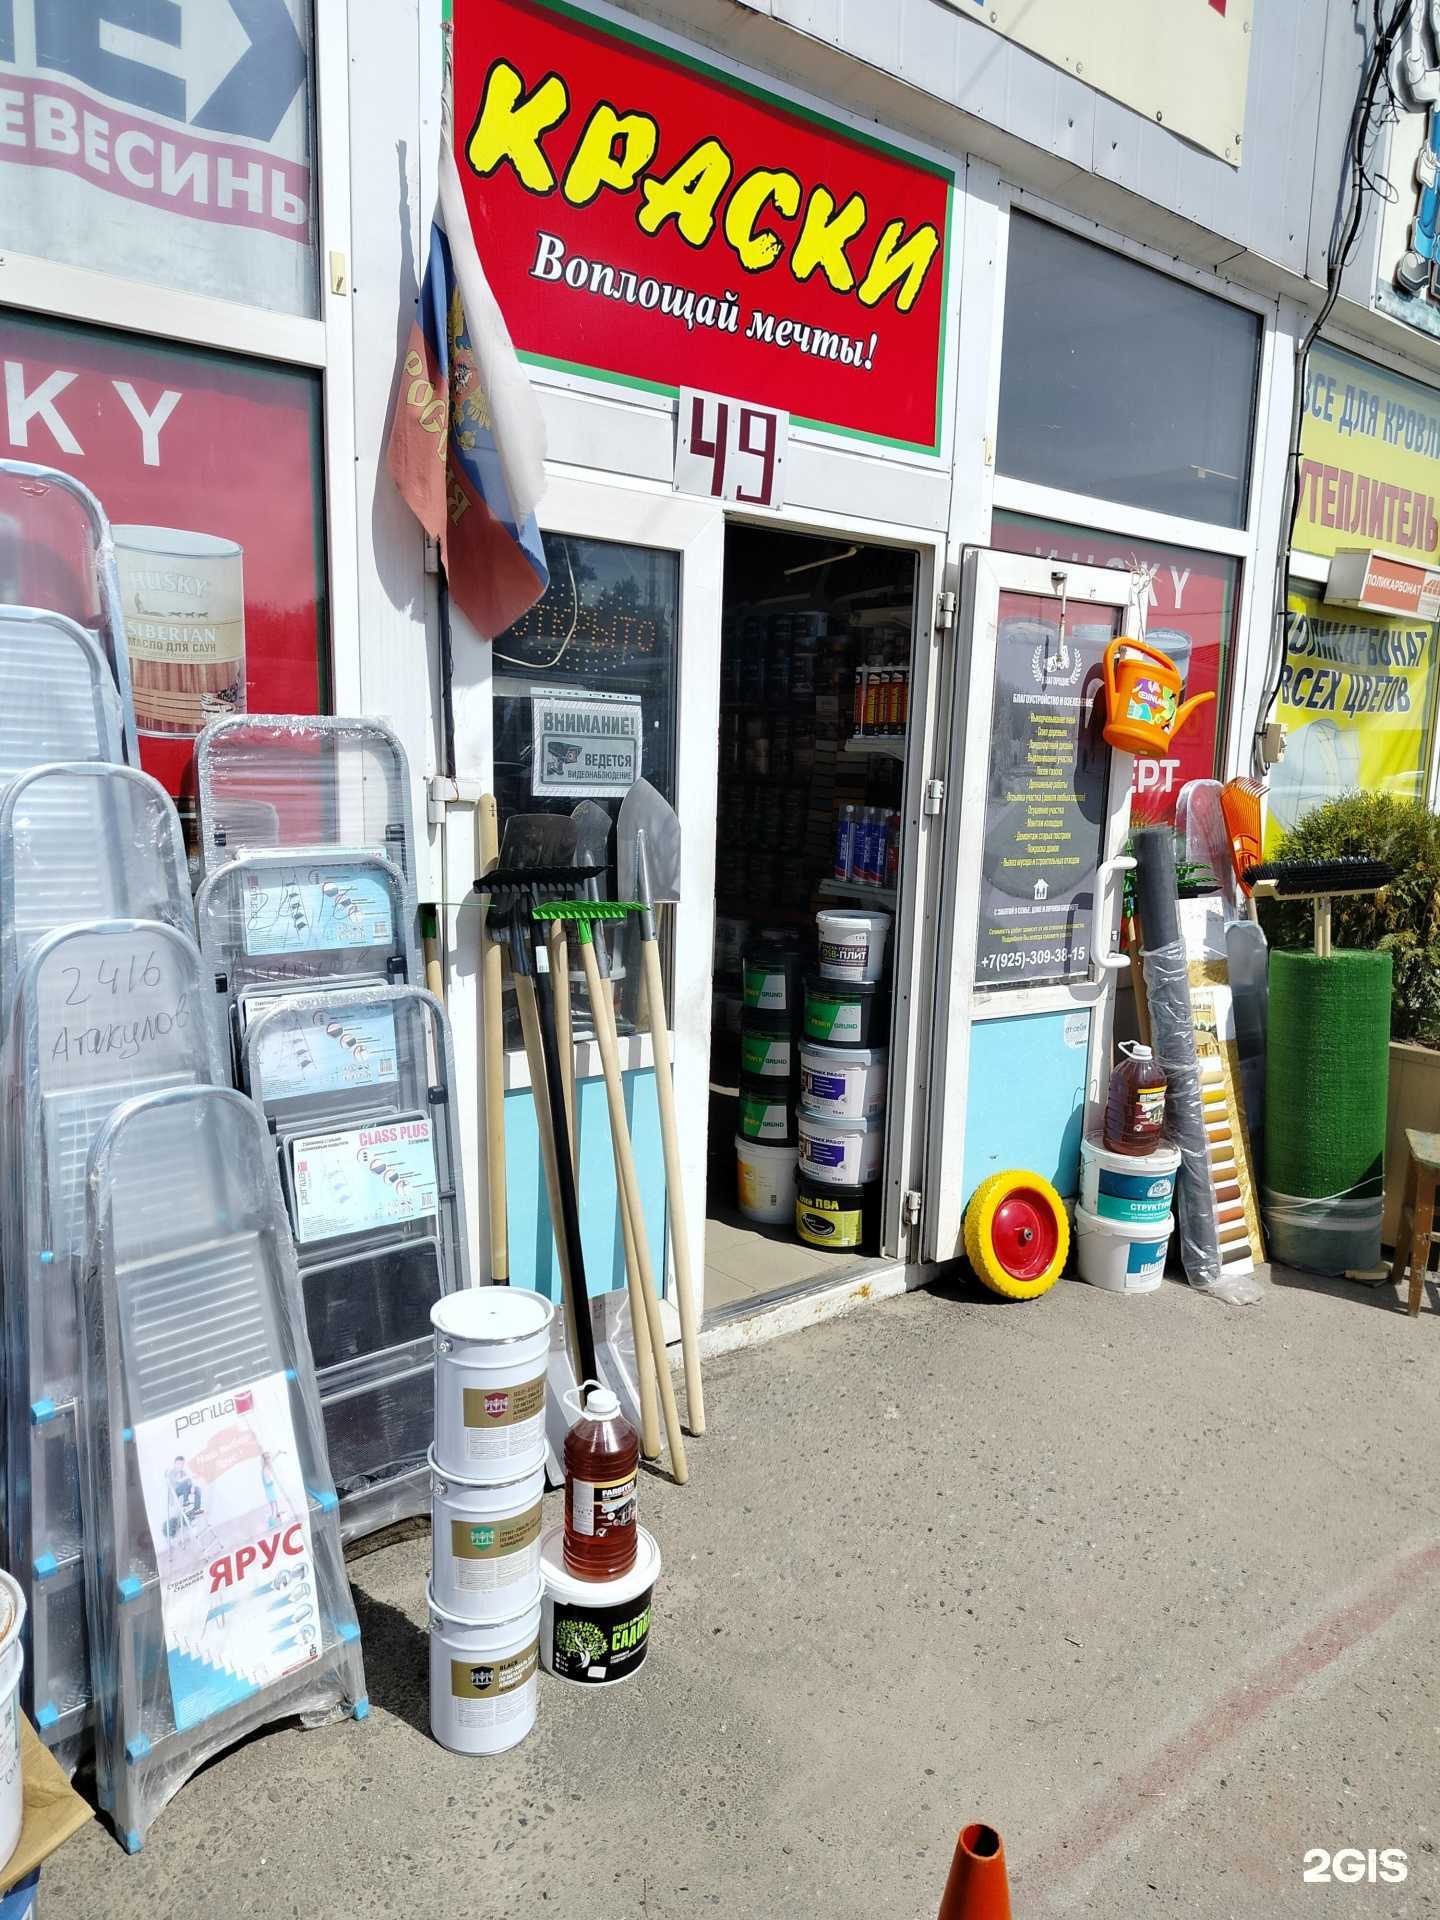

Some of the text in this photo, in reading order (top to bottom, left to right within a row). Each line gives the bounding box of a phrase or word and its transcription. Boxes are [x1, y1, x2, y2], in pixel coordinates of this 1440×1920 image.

[466, 57, 939, 312] КРАСКИ
[530, 232, 878, 370] Воплощай мечты!
[1339, 384, 1379, 437] ДЛЯ
[690, 396, 777, 506] 49
[128, 571, 209, 597] HUSKY
[1366, 574, 1422, 595] ПОЛИКАРБОНАТ
[127, 624, 217, 642] SIBERIAN
[165, 641, 189, 653] ДЛЯ
[1342, 674, 1411, 719] ЦВЕТОВ
[543, 711, 636, 736] ВНИМАНИЕ!
[584, 753, 632, 769] ВЕДЕТСЯ
[567, 770, 633, 781] ВИДЕОНАБЛЮДЕНИЕ
[981, 946, 1085, 972] +7(925)-309-38-15
[359, 1125, 398, 1147] CLASS
[399, 1123, 429, 1139] PLUS
[815, 1198, 840, 1211] ПВА
[175, 1396, 235, 1439] perilla
[209, 1522, 304, 1594] ЯРУС
